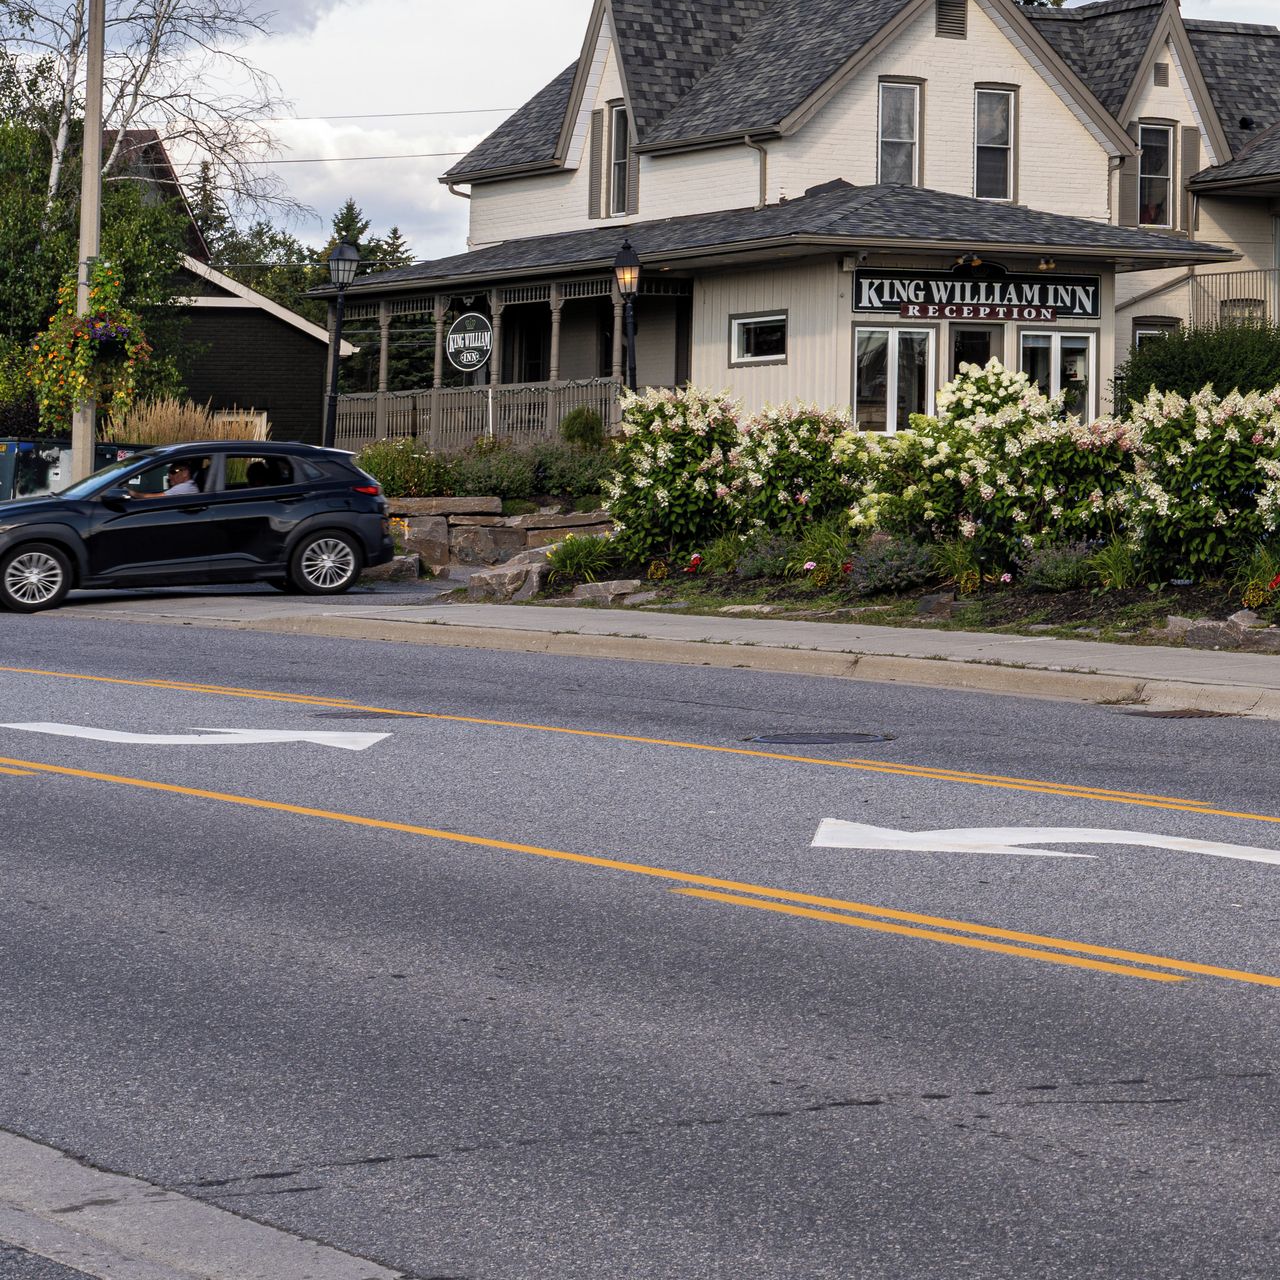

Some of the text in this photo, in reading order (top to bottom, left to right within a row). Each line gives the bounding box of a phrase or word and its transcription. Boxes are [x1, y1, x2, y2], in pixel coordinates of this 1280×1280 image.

[858, 278, 1096, 314] KING WILLIAM INN
[907, 305, 1054, 320] RECEPTION
[449, 331, 491, 352] KING WILLIAM
[463, 352, 478, 362] INN
